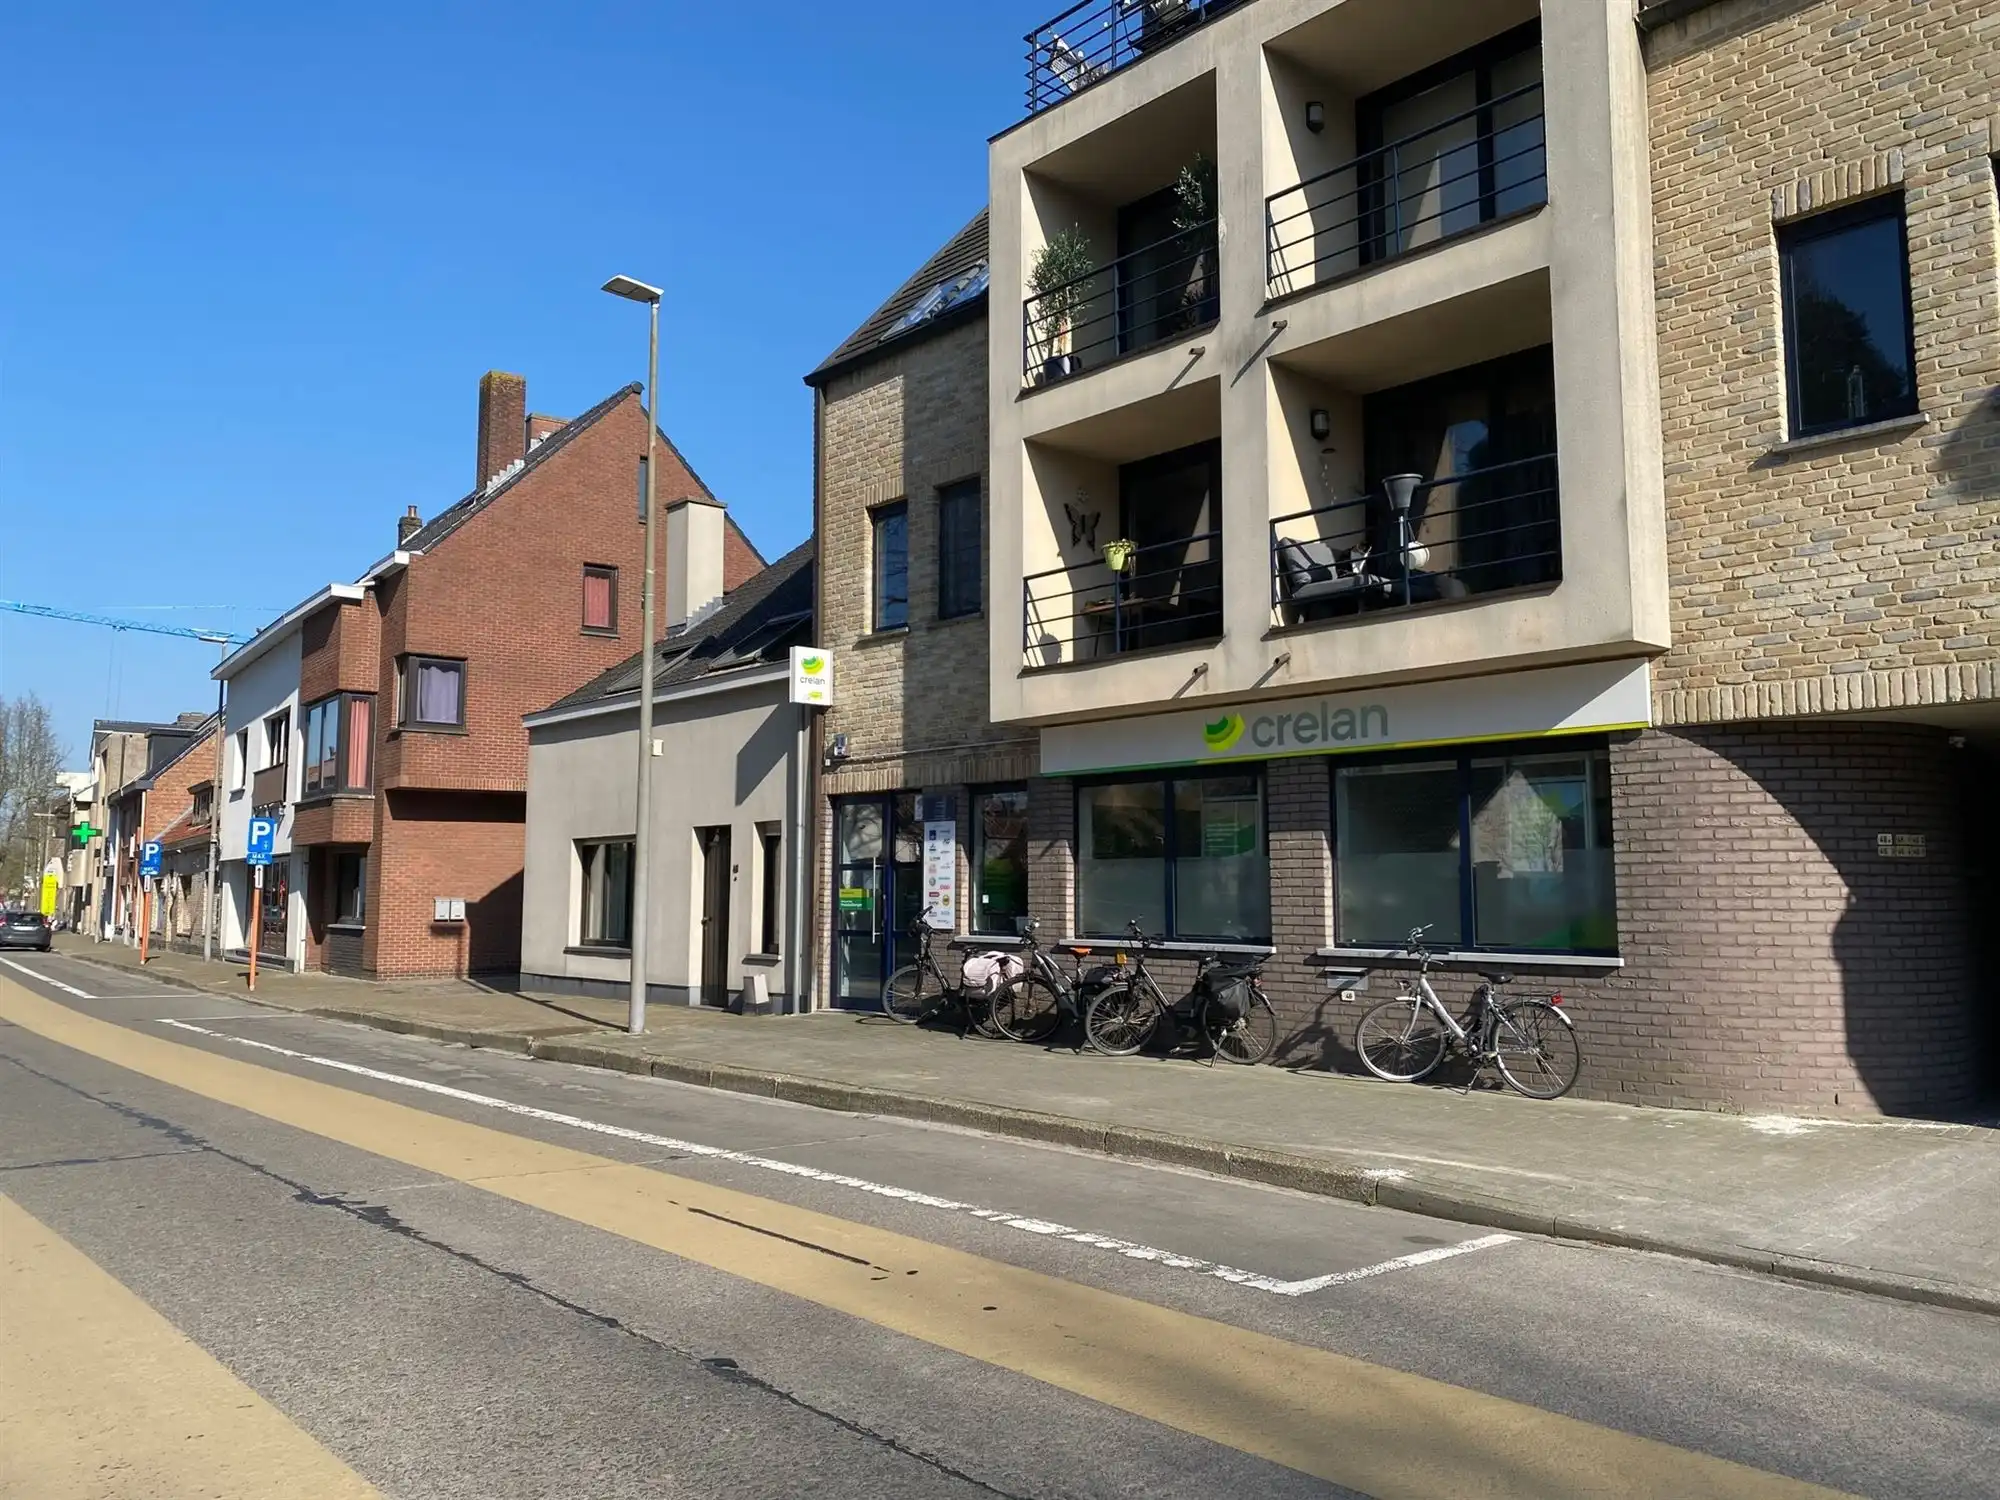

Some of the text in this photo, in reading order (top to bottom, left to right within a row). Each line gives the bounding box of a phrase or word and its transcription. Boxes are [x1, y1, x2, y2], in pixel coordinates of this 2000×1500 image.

[800, 676, 825, 685] crelan
[1251, 700, 1389, 748] crelan
[251, 821, 270, 845] P
[145, 843, 159, 861] P
